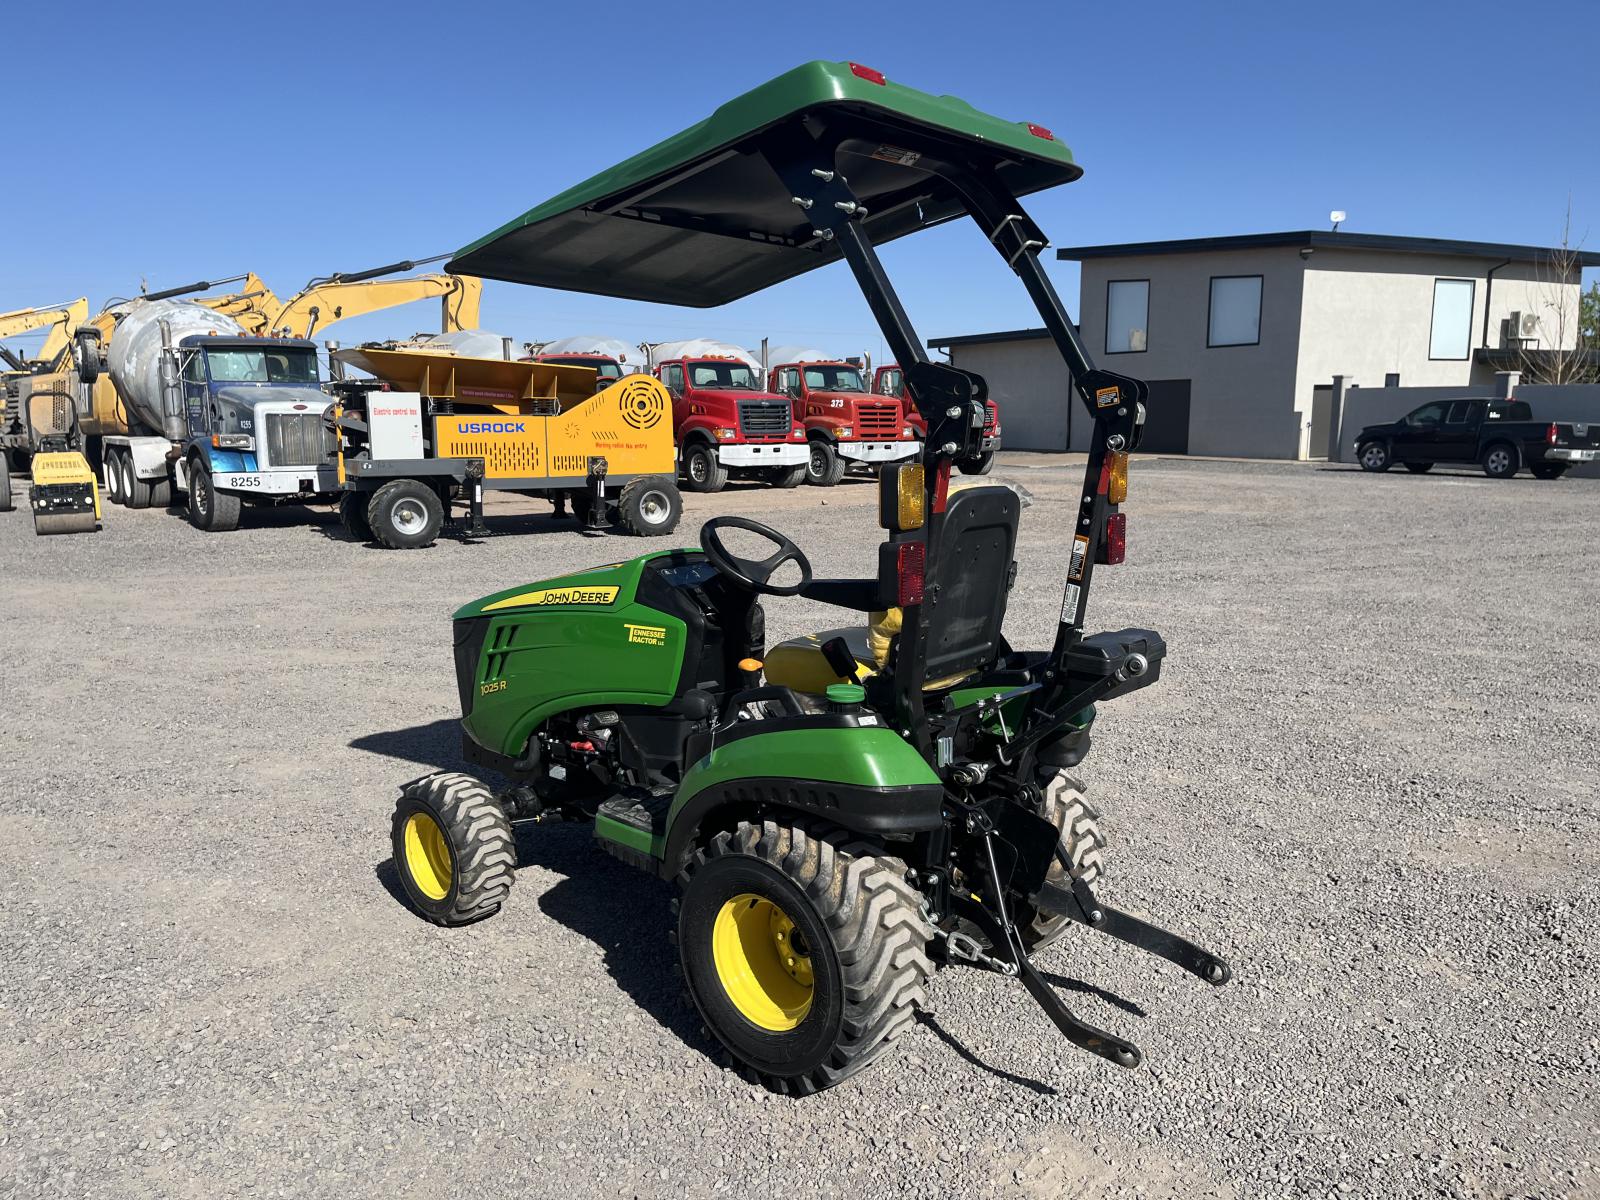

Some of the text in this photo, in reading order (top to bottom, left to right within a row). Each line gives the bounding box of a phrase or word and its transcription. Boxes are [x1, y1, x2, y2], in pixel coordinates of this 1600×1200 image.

[830, 399, 844, 408] 373
[373, 407, 417, 416] Electric control box
[240, 420, 252, 429] 8255
[458, 422, 526, 434] USROCK
[230, 477, 261, 488] 8255
[540, 590, 611, 604] JOHN DEERE
[624, 624, 666, 641] TENNESSEE
